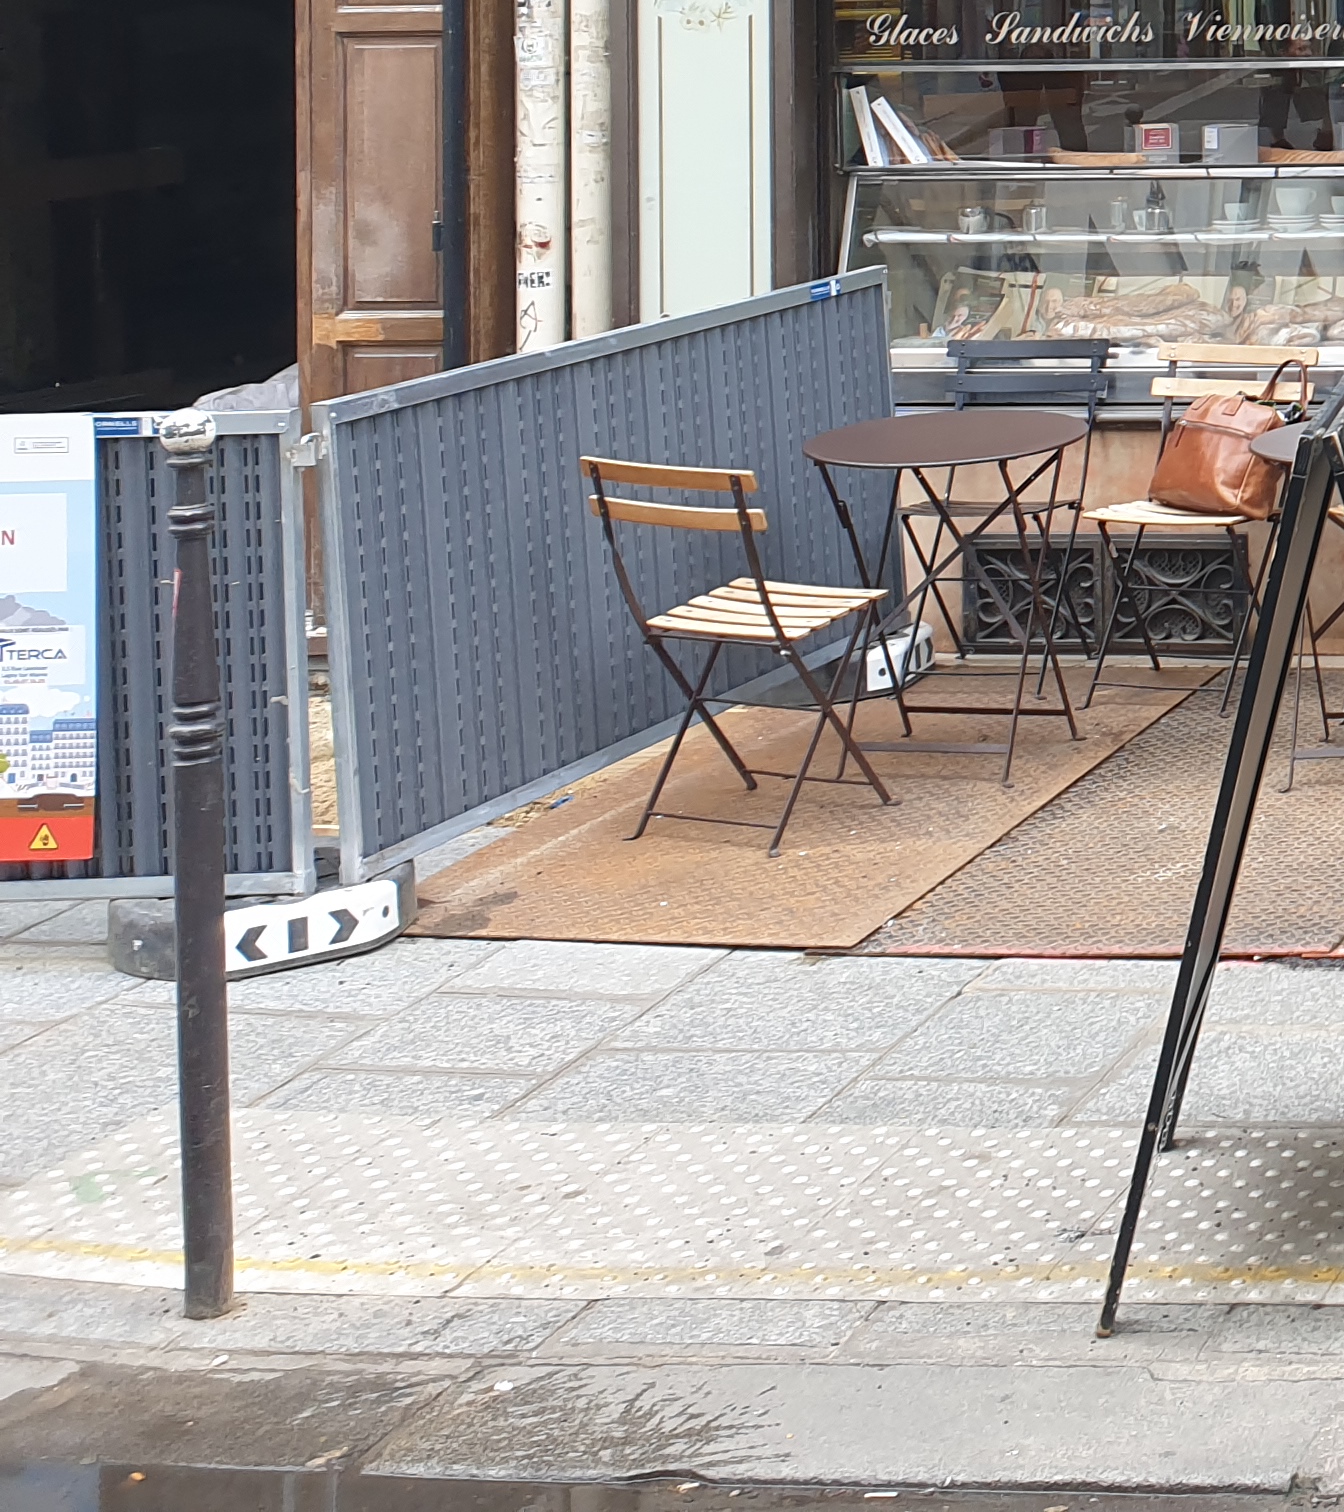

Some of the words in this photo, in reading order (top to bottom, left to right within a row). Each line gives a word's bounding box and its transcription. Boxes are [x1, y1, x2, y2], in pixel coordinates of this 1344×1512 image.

[866, 12, 960, 46] Glaces
[984, 10, 1155, 46] Sandwichs
[6, 648, 68, 661] TERCA
